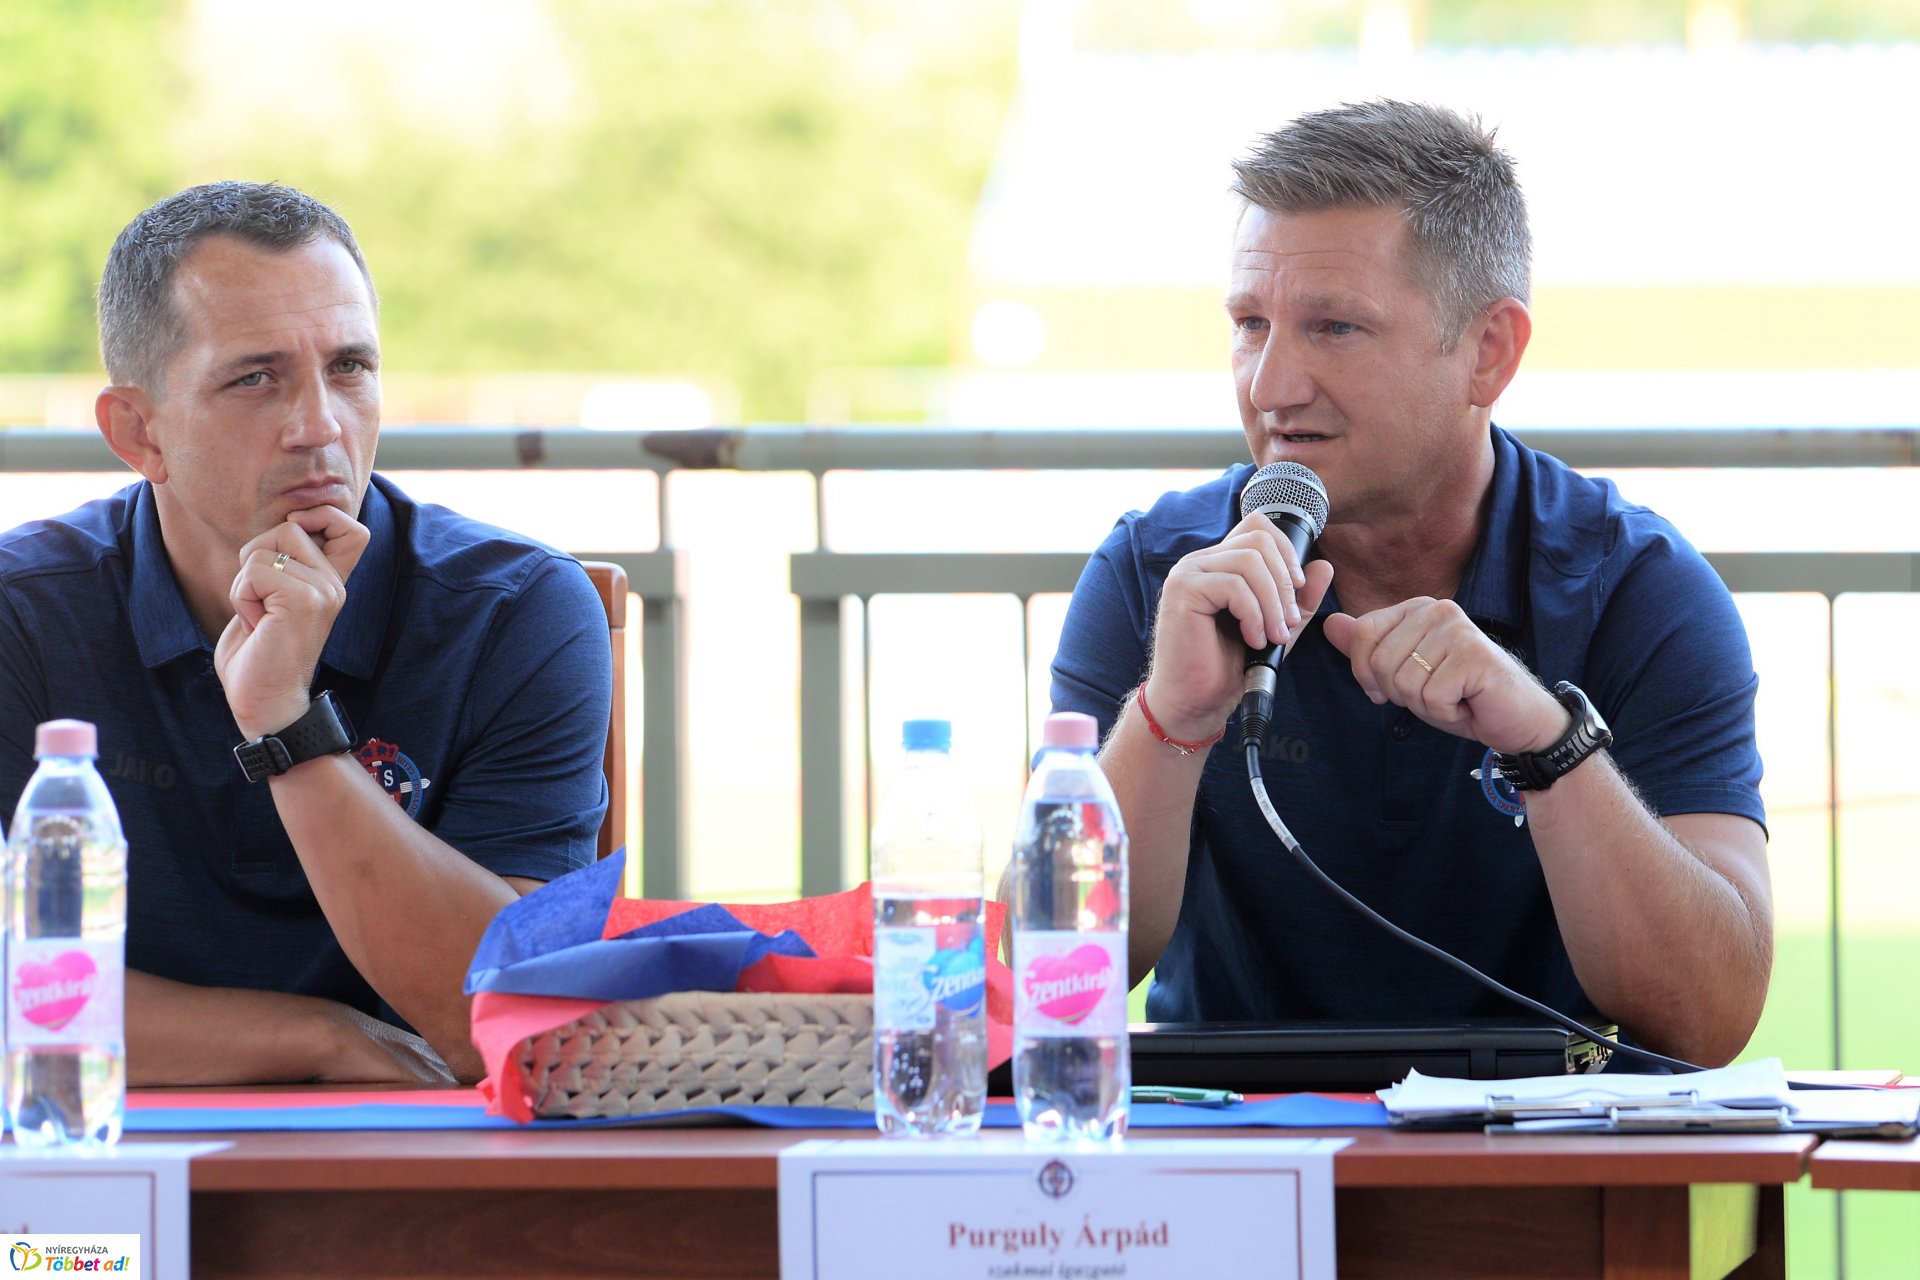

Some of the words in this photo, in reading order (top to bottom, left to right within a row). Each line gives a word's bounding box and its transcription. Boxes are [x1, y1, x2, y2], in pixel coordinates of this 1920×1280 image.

[109, 752, 177, 790] JAKO
[948, 1221, 1063, 1255] Purguly
[1075, 1213, 1169, 1254] Árpád
